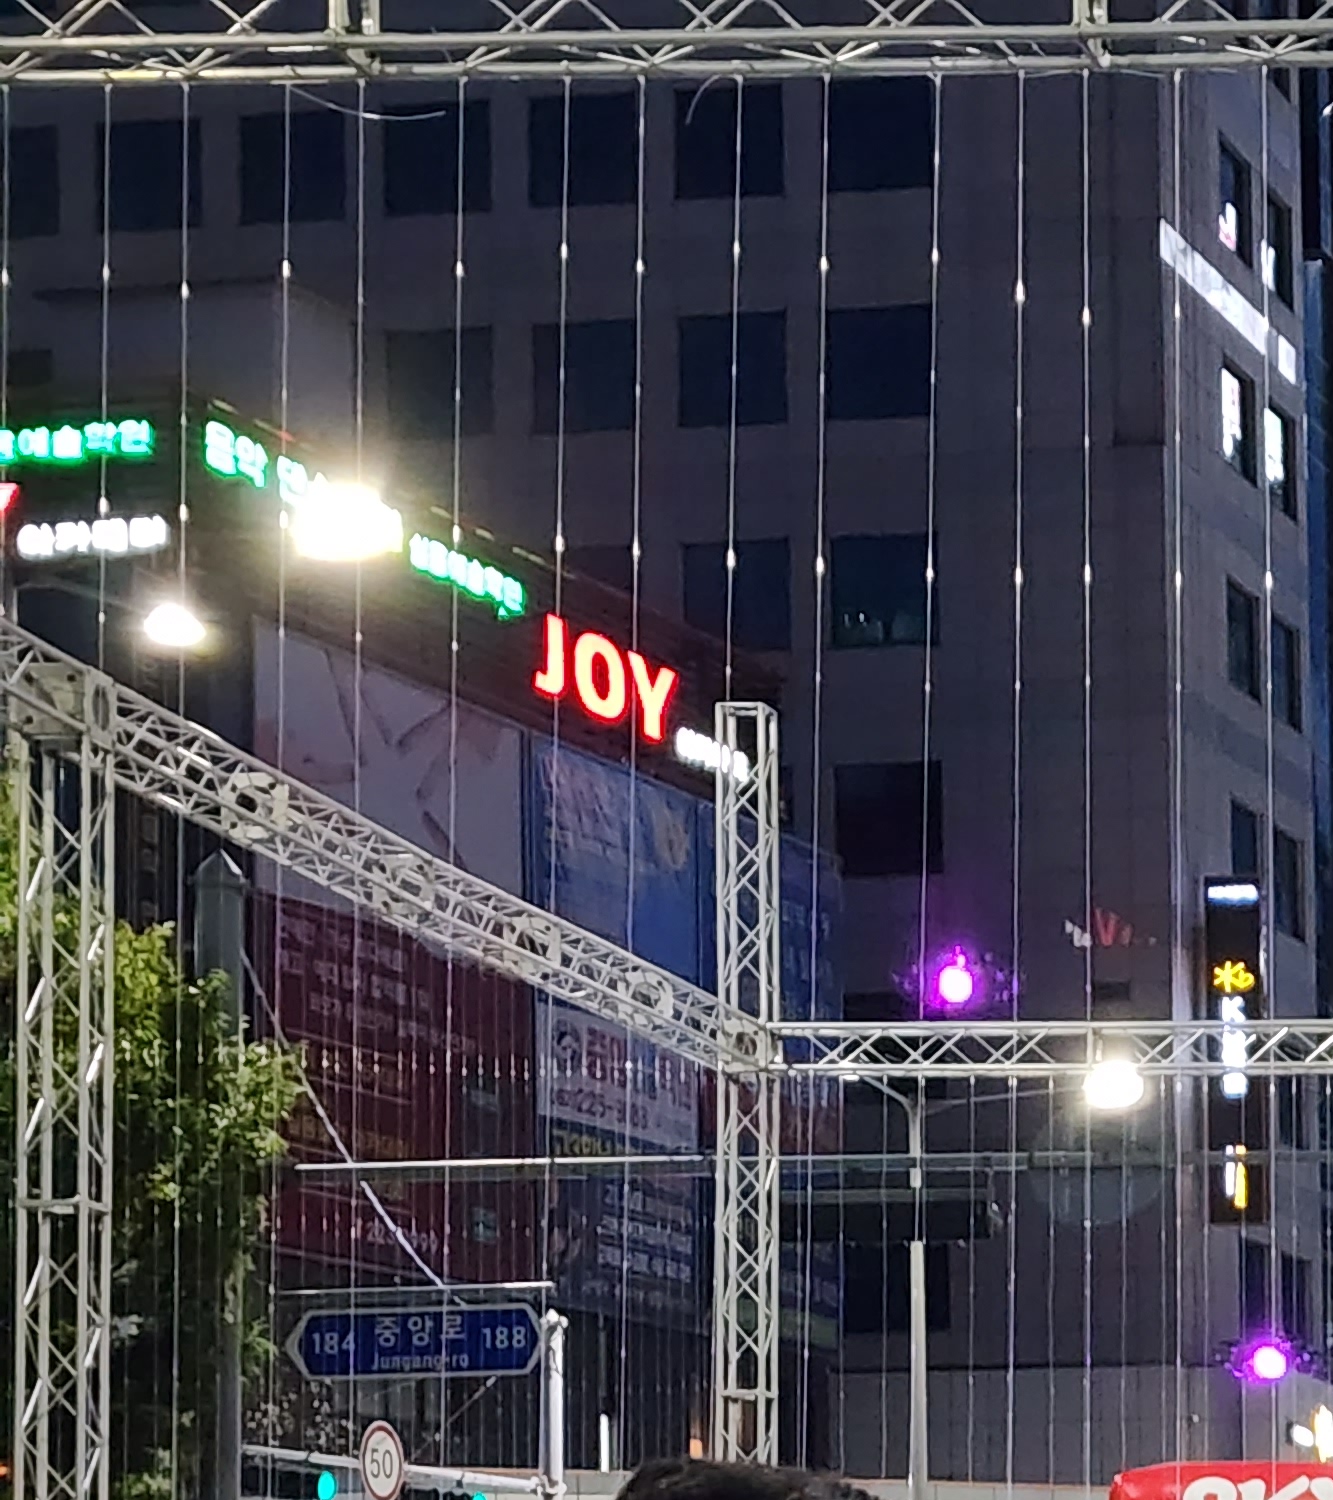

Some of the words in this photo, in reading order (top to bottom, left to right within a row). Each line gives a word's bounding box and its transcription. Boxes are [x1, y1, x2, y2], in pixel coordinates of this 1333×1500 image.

[533, 613, 680, 743] JOY
[374, 1315, 466, 1347] 중앙로
[482, 1327, 527, 1350] 188
[371, 1352, 470, 1371] Jungang-ro
[369, 1448, 394, 1480] 50
